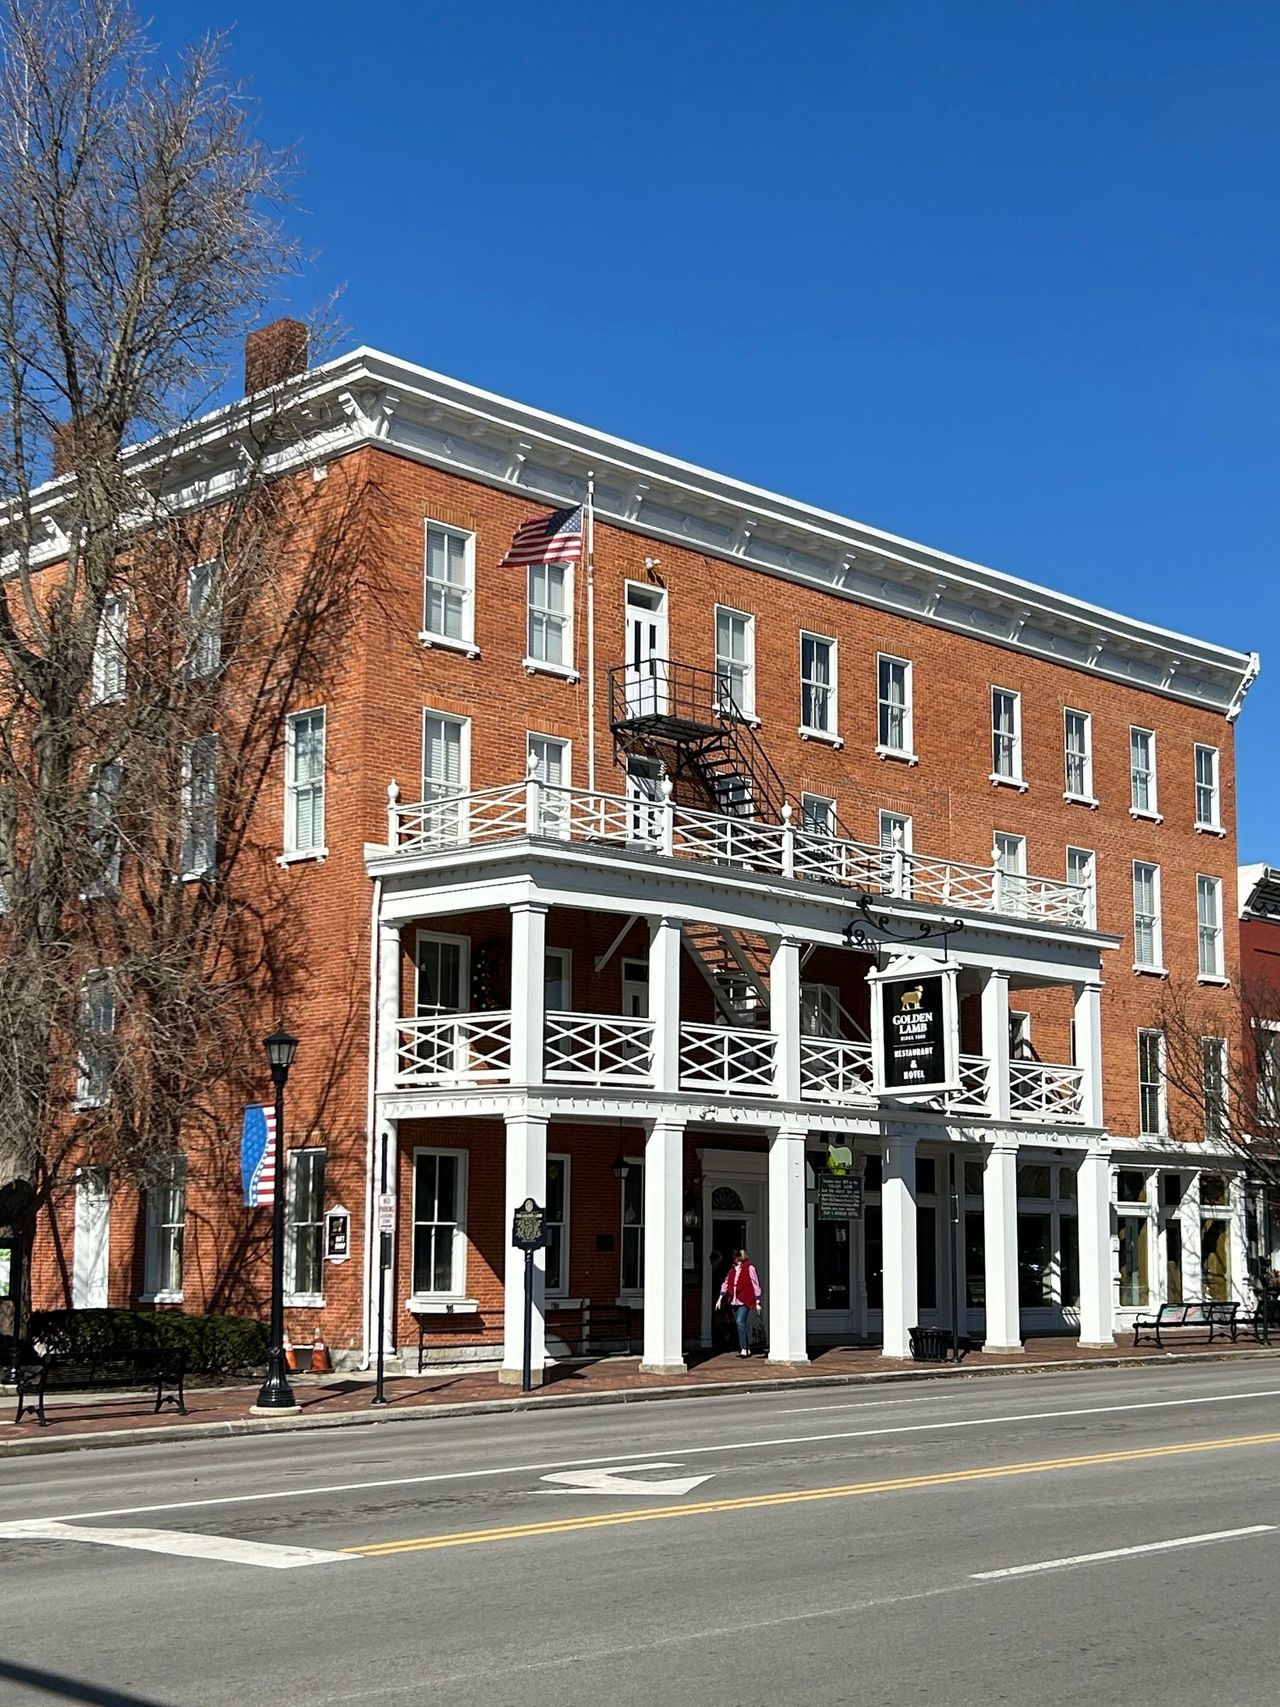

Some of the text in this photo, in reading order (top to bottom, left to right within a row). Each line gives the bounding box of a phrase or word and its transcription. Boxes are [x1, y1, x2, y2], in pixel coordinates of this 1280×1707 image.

[892, 1012, 933, 1025] GOLDEN
[899, 1023, 928, 1035] LAMB
[894, 1047, 933, 1058] RESTAURANT
[910, 1059, 918, 1069] &
[903, 1070, 925, 1080] HOTEL
